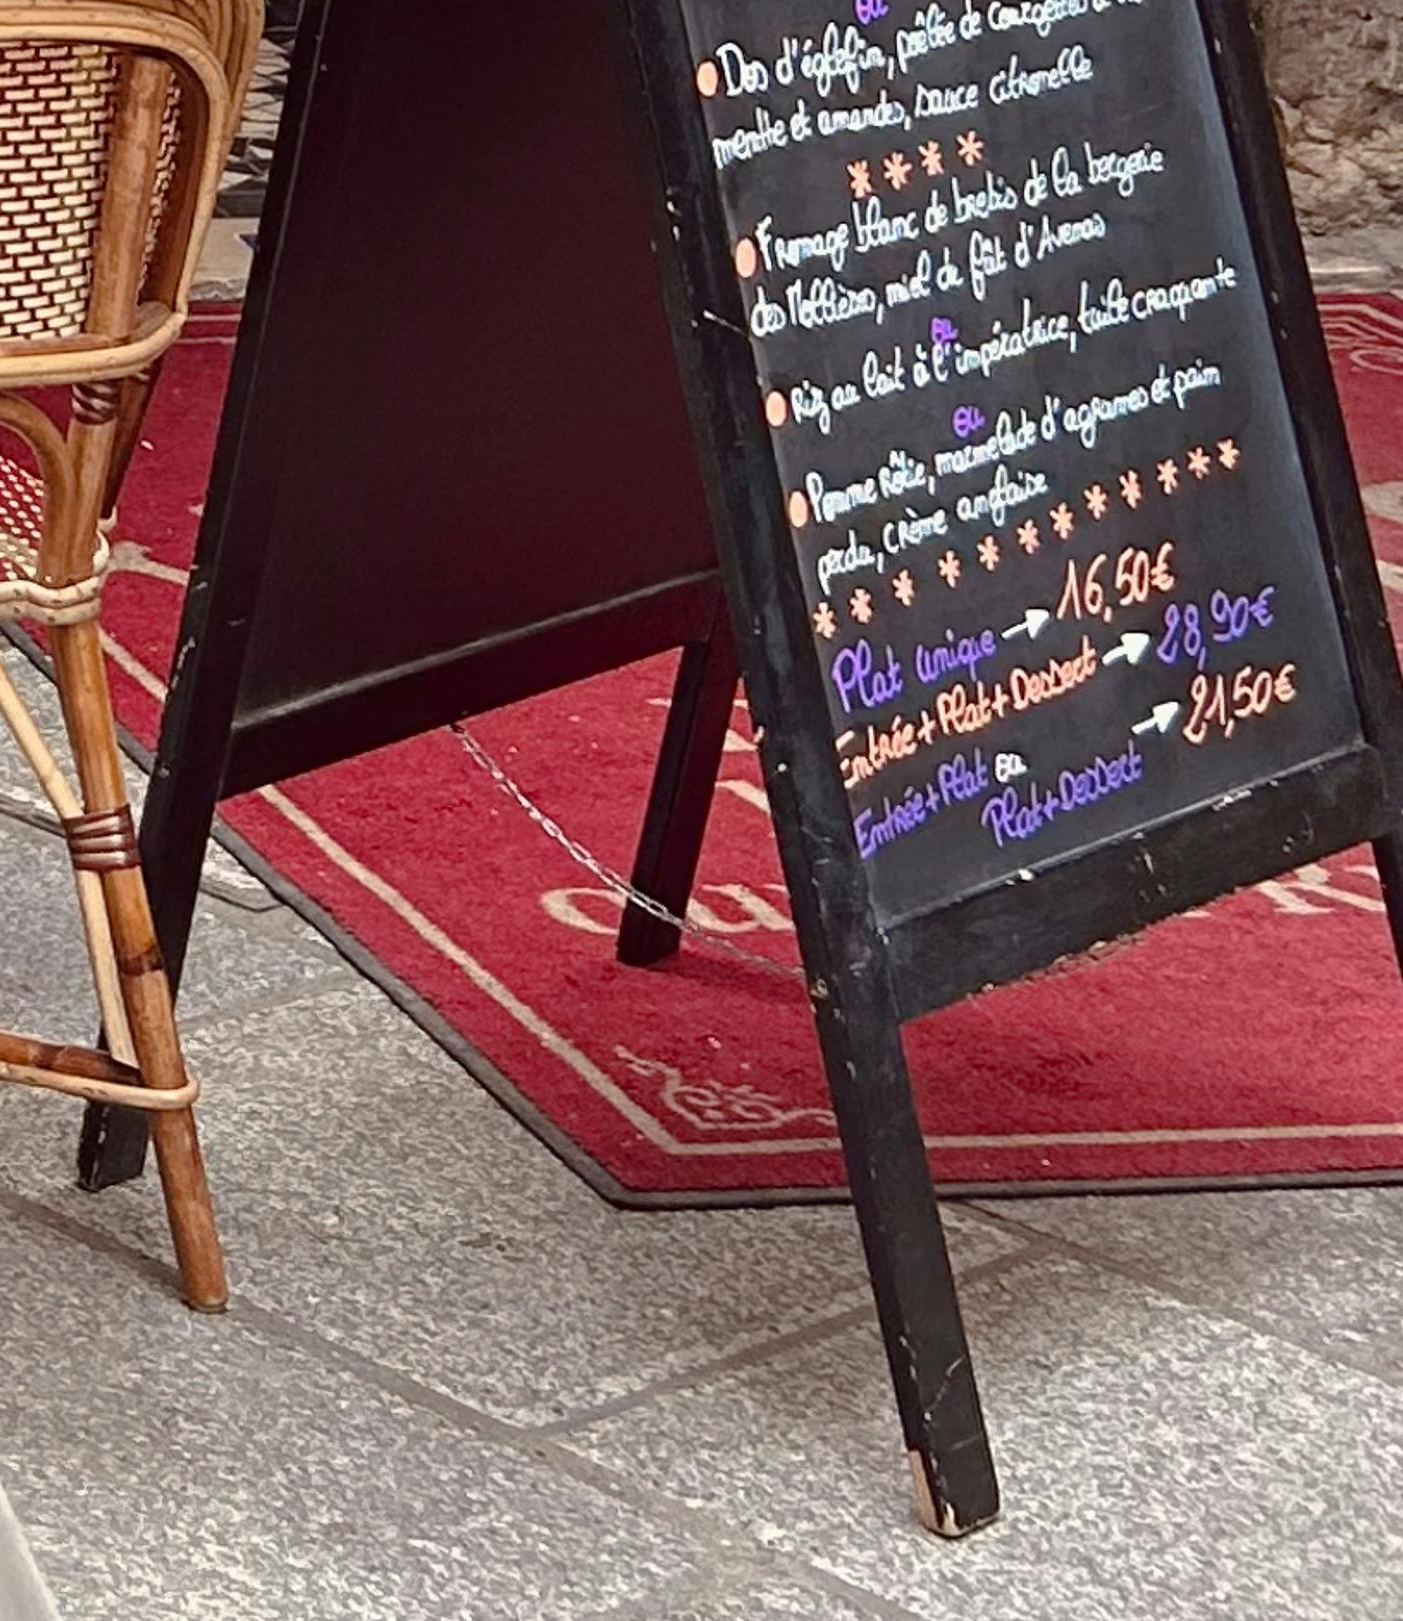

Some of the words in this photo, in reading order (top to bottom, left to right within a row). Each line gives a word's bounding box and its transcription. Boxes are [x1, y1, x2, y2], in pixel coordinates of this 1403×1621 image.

[715, 41, 769, 97] Dos
[790, 98, 814, 142] et
[914, 83, 979, 118] sauce
[755, 215, 850, 272] Fromage
[851, 195, 920, 253] blanc
[924, 189, 949, 234] de
[951, 170, 1018, 224] brebis
[1023, 157, 1048, 208] de
[1051, 145, 1084, 198] la
[1083, 140, 1164, 198] bergerie
[750, 285, 787, 337] des
[884, 249, 932, 308] miel
[790, 379, 831, 436] Riz
[831, 383, 862, 411] au
[862, 345, 906, 399] lait
[912, 343, 931, 388] à
[1078, 277, 1130, 336] tuile
[805, 471, 878, 524] Pomme
[933, 408, 1037, 476] marmelade
[1151, 363, 1172, 404] et
[1173, 358, 1222, 410] pain
[956, 463, 1048, 528] anglaise
[832, 639, 903, 714] Plat
[916, 628, 997, 682] unique
[1057, 541, 1177, 623] 16,50€
[1156, 585, 1275, 671] 28,90€
[1182, 662, 1297, 745] 21,50€
